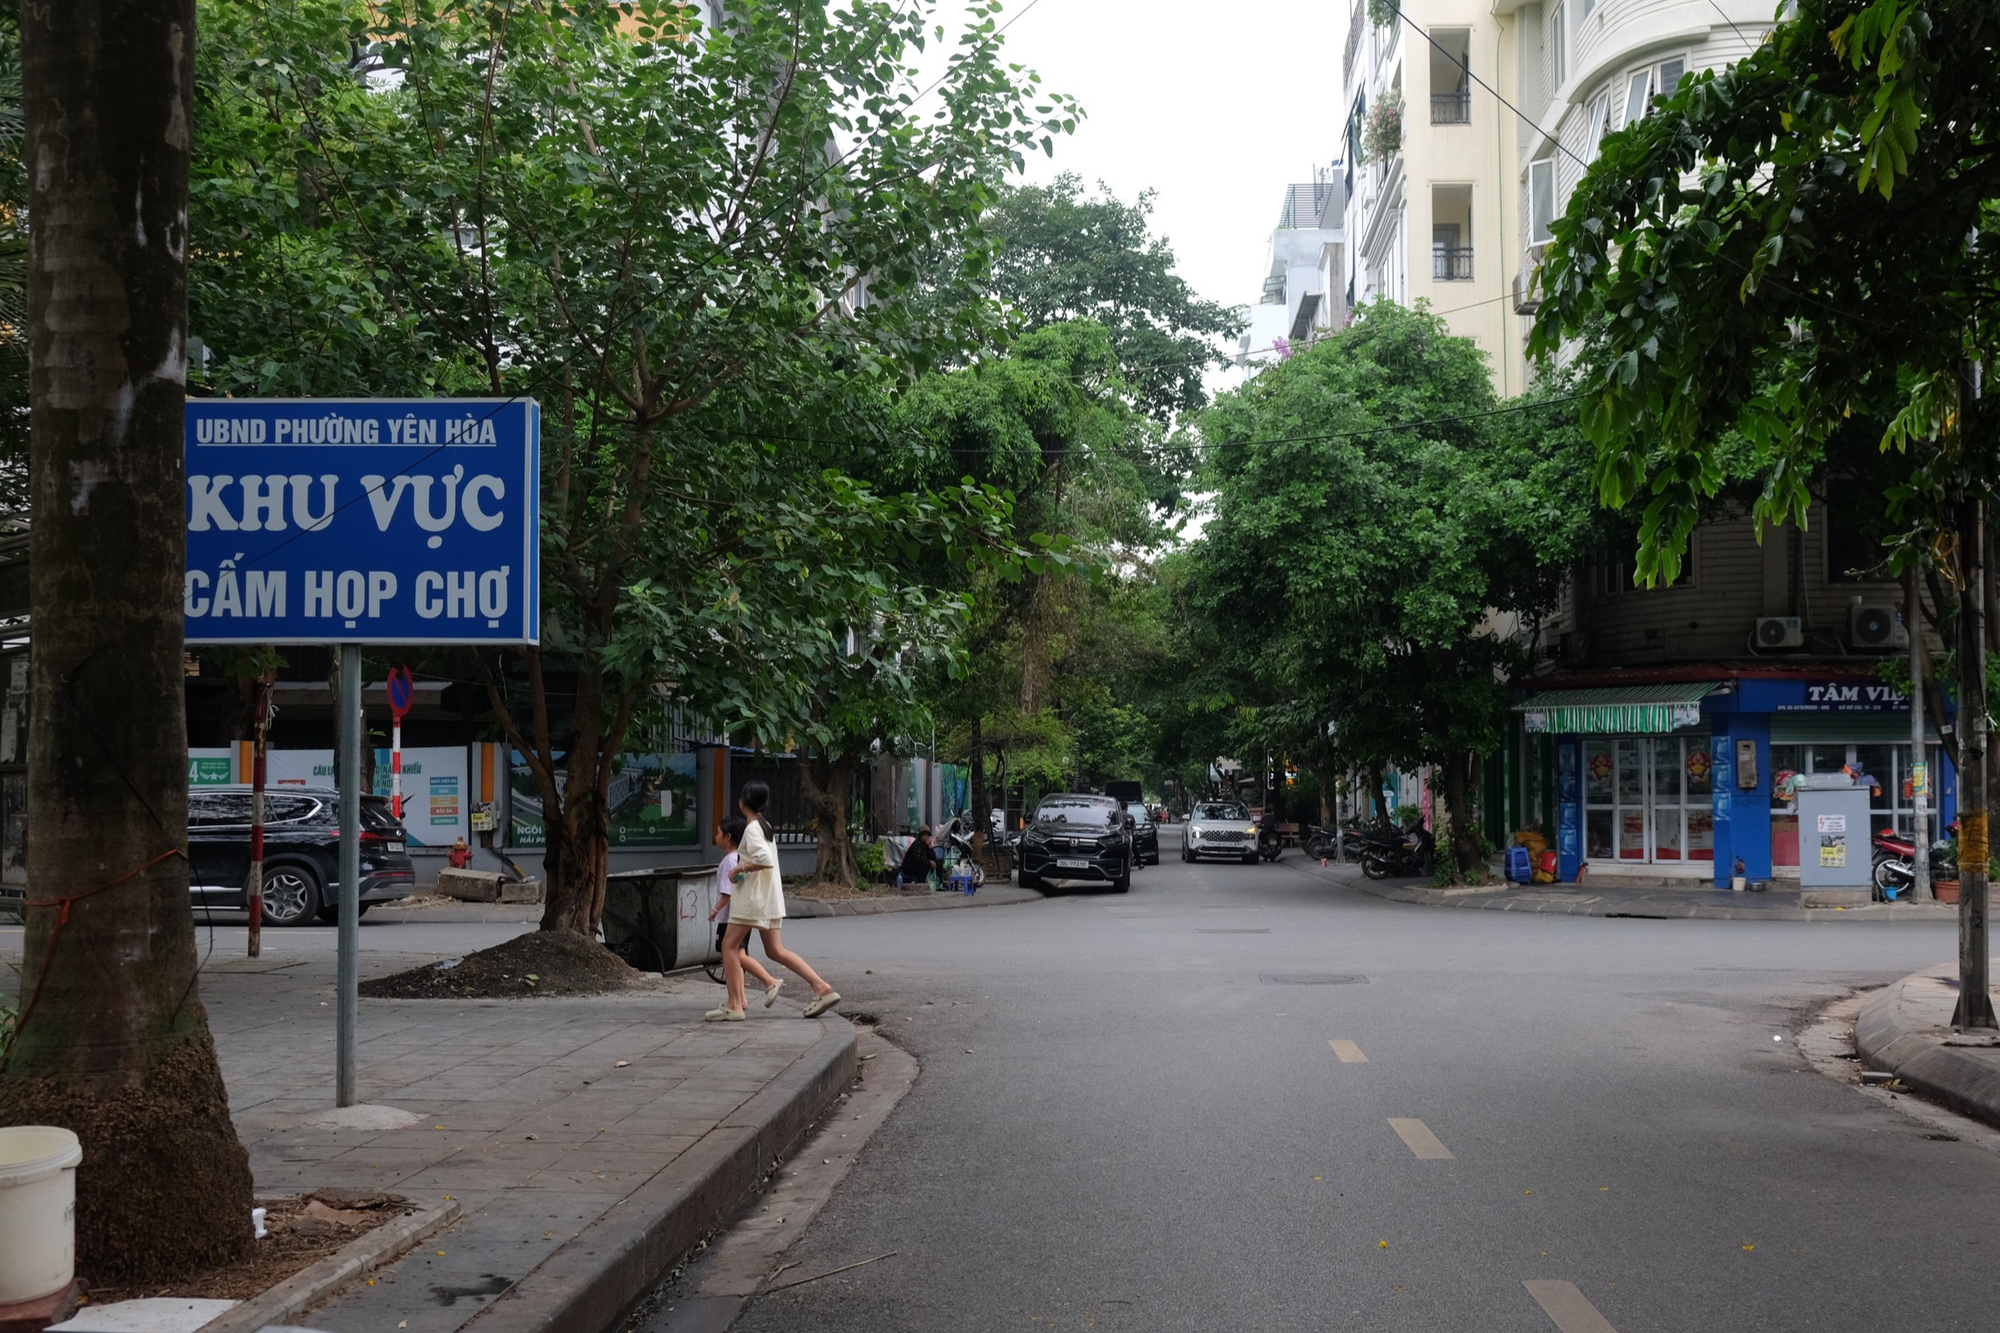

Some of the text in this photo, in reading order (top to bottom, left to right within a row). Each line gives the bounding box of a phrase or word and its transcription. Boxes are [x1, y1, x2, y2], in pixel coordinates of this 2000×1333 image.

[197, 412, 497, 444] UBND PHƯỜNG YÊN HÒA
[187, 463, 505, 549] KHU VỰC
[184, 552, 510, 628] CẤM HỌP CHỢ
[1808, 682, 1860, 701] TÂM
[517, 824, 542, 835] NGÔI
